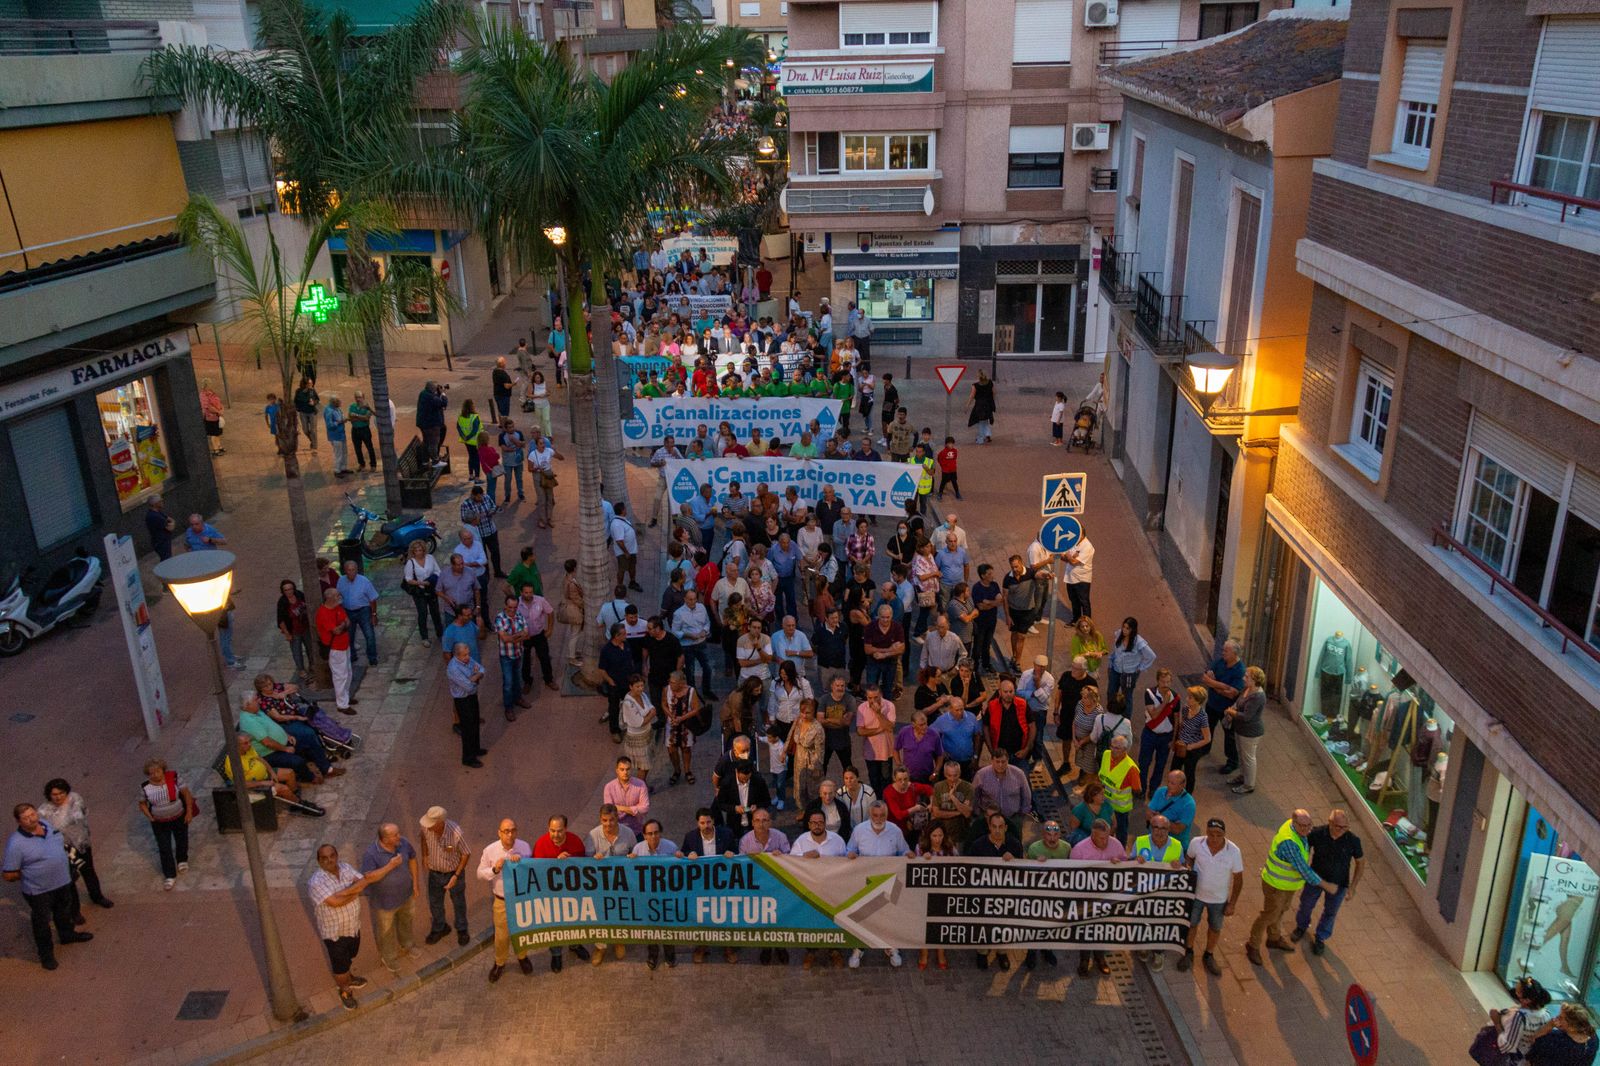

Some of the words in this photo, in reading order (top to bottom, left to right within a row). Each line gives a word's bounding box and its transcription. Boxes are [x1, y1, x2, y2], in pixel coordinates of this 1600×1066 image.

[787, 69, 808, 81] Dra.
[829, 68, 856, 81] Luisa
[858, 67, 882, 81] Ruiz
[70, 338, 176, 386] FARMACIA
[655, 404, 802, 424] ¡Canalizaciones
[707, 463, 877, 487] ¡Canalizaciones
[848, 487, 887, 508] YA!
[512, 867, 542, 897] LA
[546, 865, 630, 892] COSTA
[634, 862, 760, 893] TROPICAL
[911, 867, 938, 886] PER
[942, 866, 966, 886] LES
[970, 867, 1108, 891] CANALITZACIONS
[1112, 871, 1134, 892] DE
[1137, 871, 1193, 893] RULES.
[1558, 879, 1578, 889] PIN
[1582, 883, 1599, 892] UP
[515, 896, 598, 928] UNIDA
[603, 896, 643, 922] PEL
[647, 897, 689, 923] SEU
[696, 896, 778, 924] FUTUR
[946, 896, 980, 915] PELS
[984, 897, 1065, 920] ESPIGONS
[1067, 900, 1079, 920] A
[1083, 902, 1112, 920] LES
[1114, 899, 1190, 918] PLATGES.
[518, 928, 588, 947] PLATAFORMA
[588, 928, 608, 939] PER
[610, 928, 629, 940] LES
[630, 929, 732, 942] INFRAESTRUCTURES
[733, 931, 747, 941] DE
[748, 931, 761, 942] LA
[763, 931, 795, 942] COSTA
[797, 932, 846, 944] TROPICAL
[940, 925, 967, 943] PER
[970, 925, 987, 944] LA
[1075, 923, 1186, 944] FERROVIÀRIA.
